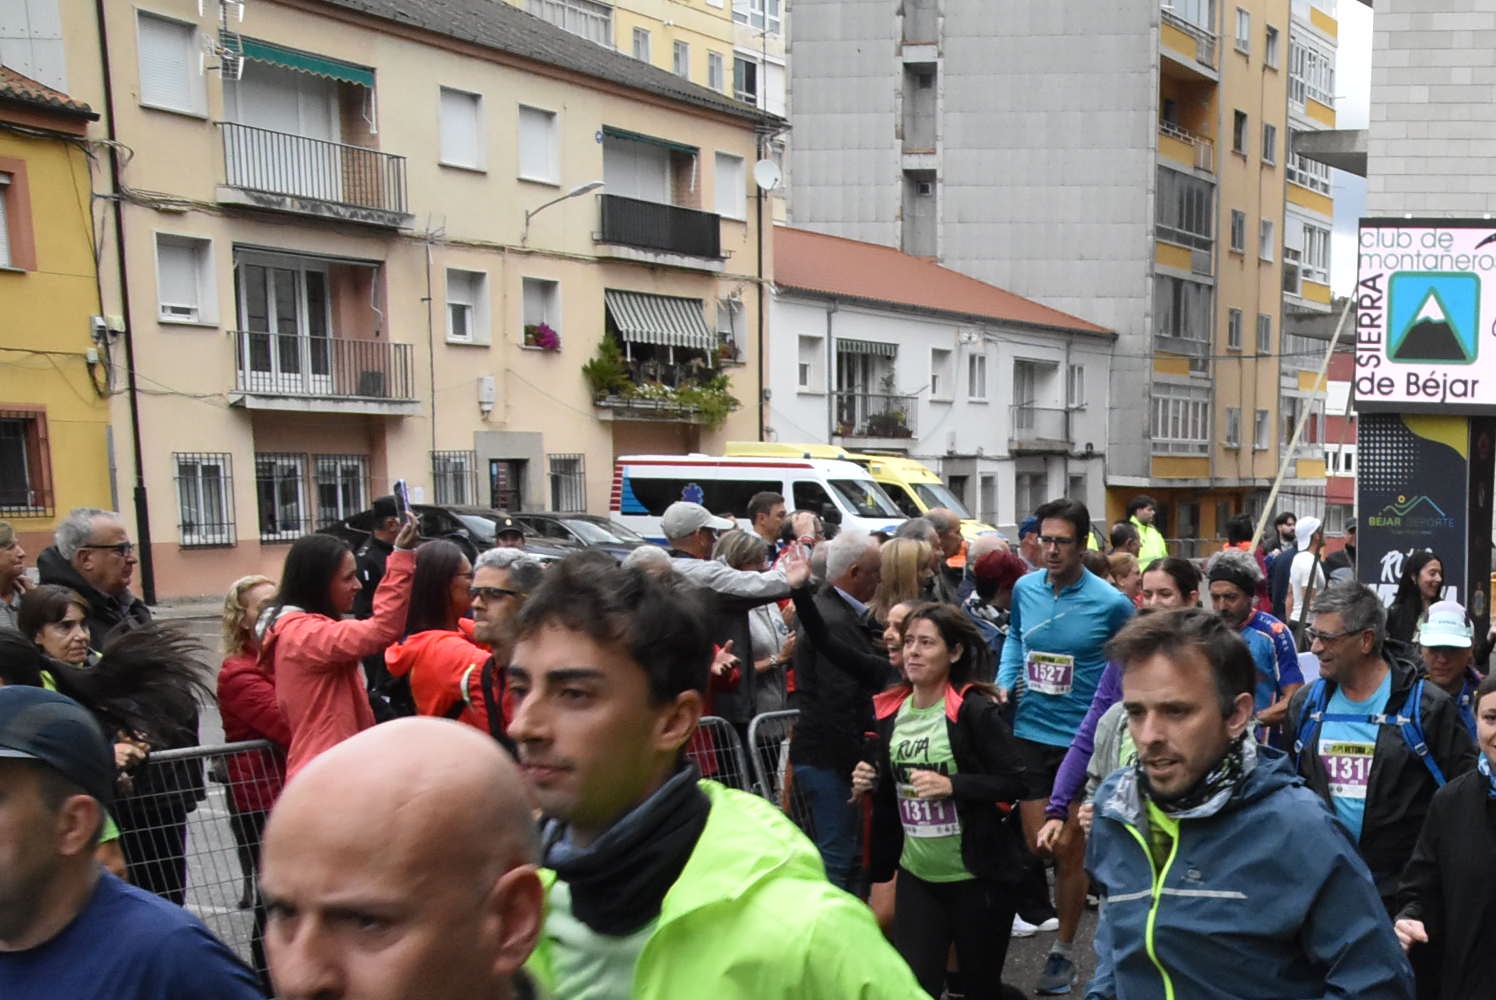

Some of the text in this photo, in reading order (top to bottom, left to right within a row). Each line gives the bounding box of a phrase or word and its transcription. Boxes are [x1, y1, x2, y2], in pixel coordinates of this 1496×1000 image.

[1360, 227, 1453, 251] club de
[1357, 273, 1383, 368] SIERRA
[1356, 371, 1479, 403] de Béjar
[1032, 662, 1066, 682] 1527
[897, 737, 930, 762] RUTA
[903, 800, 944, 820] 1311
